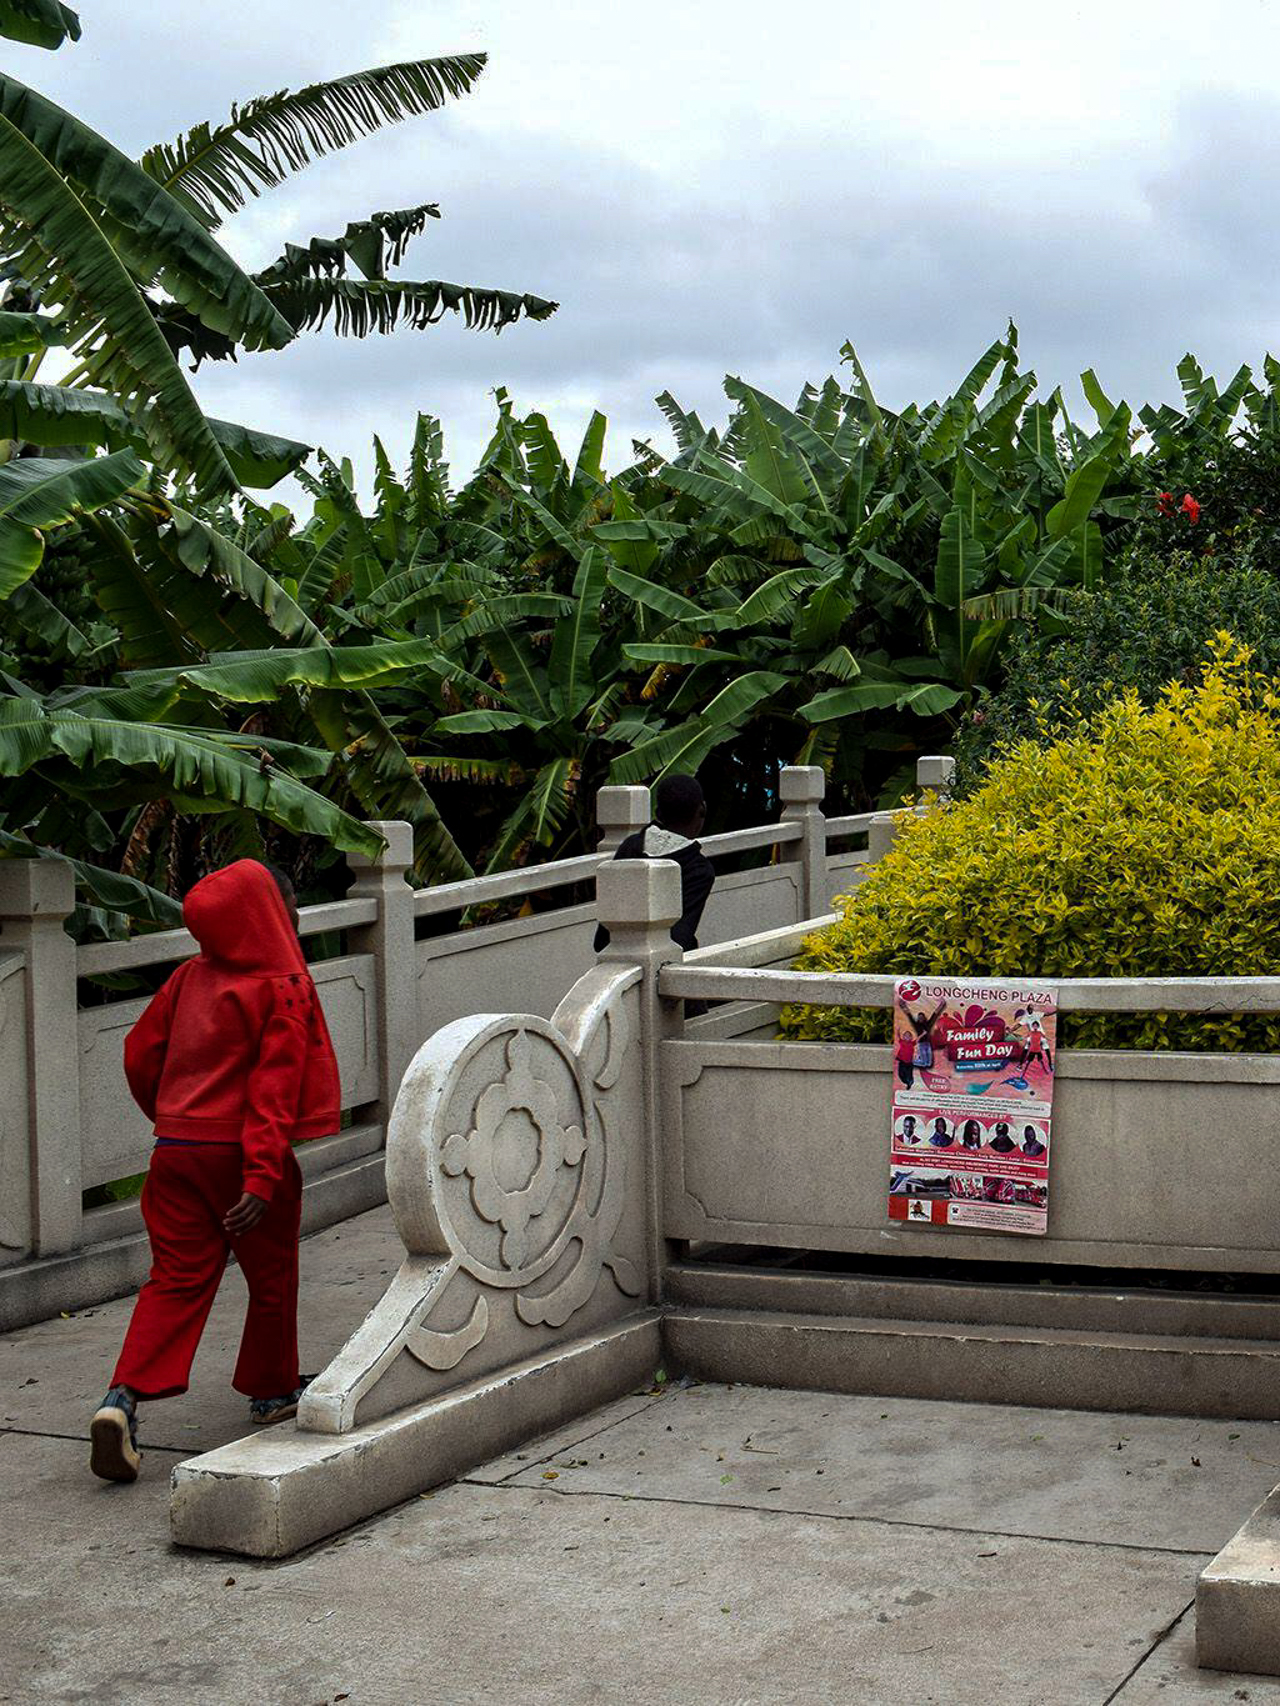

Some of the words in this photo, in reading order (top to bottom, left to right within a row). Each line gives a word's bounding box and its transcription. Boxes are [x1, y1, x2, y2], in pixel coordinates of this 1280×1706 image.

[926, 986, 1008, 1001] LONGCHENG
[1011, 992, 1052, 1004] PLAZA
[947, 1028, 994, 1041] Family
[956, 1047, 982, 1059] Fun
[985, 1043, 1013, 1057] Day
